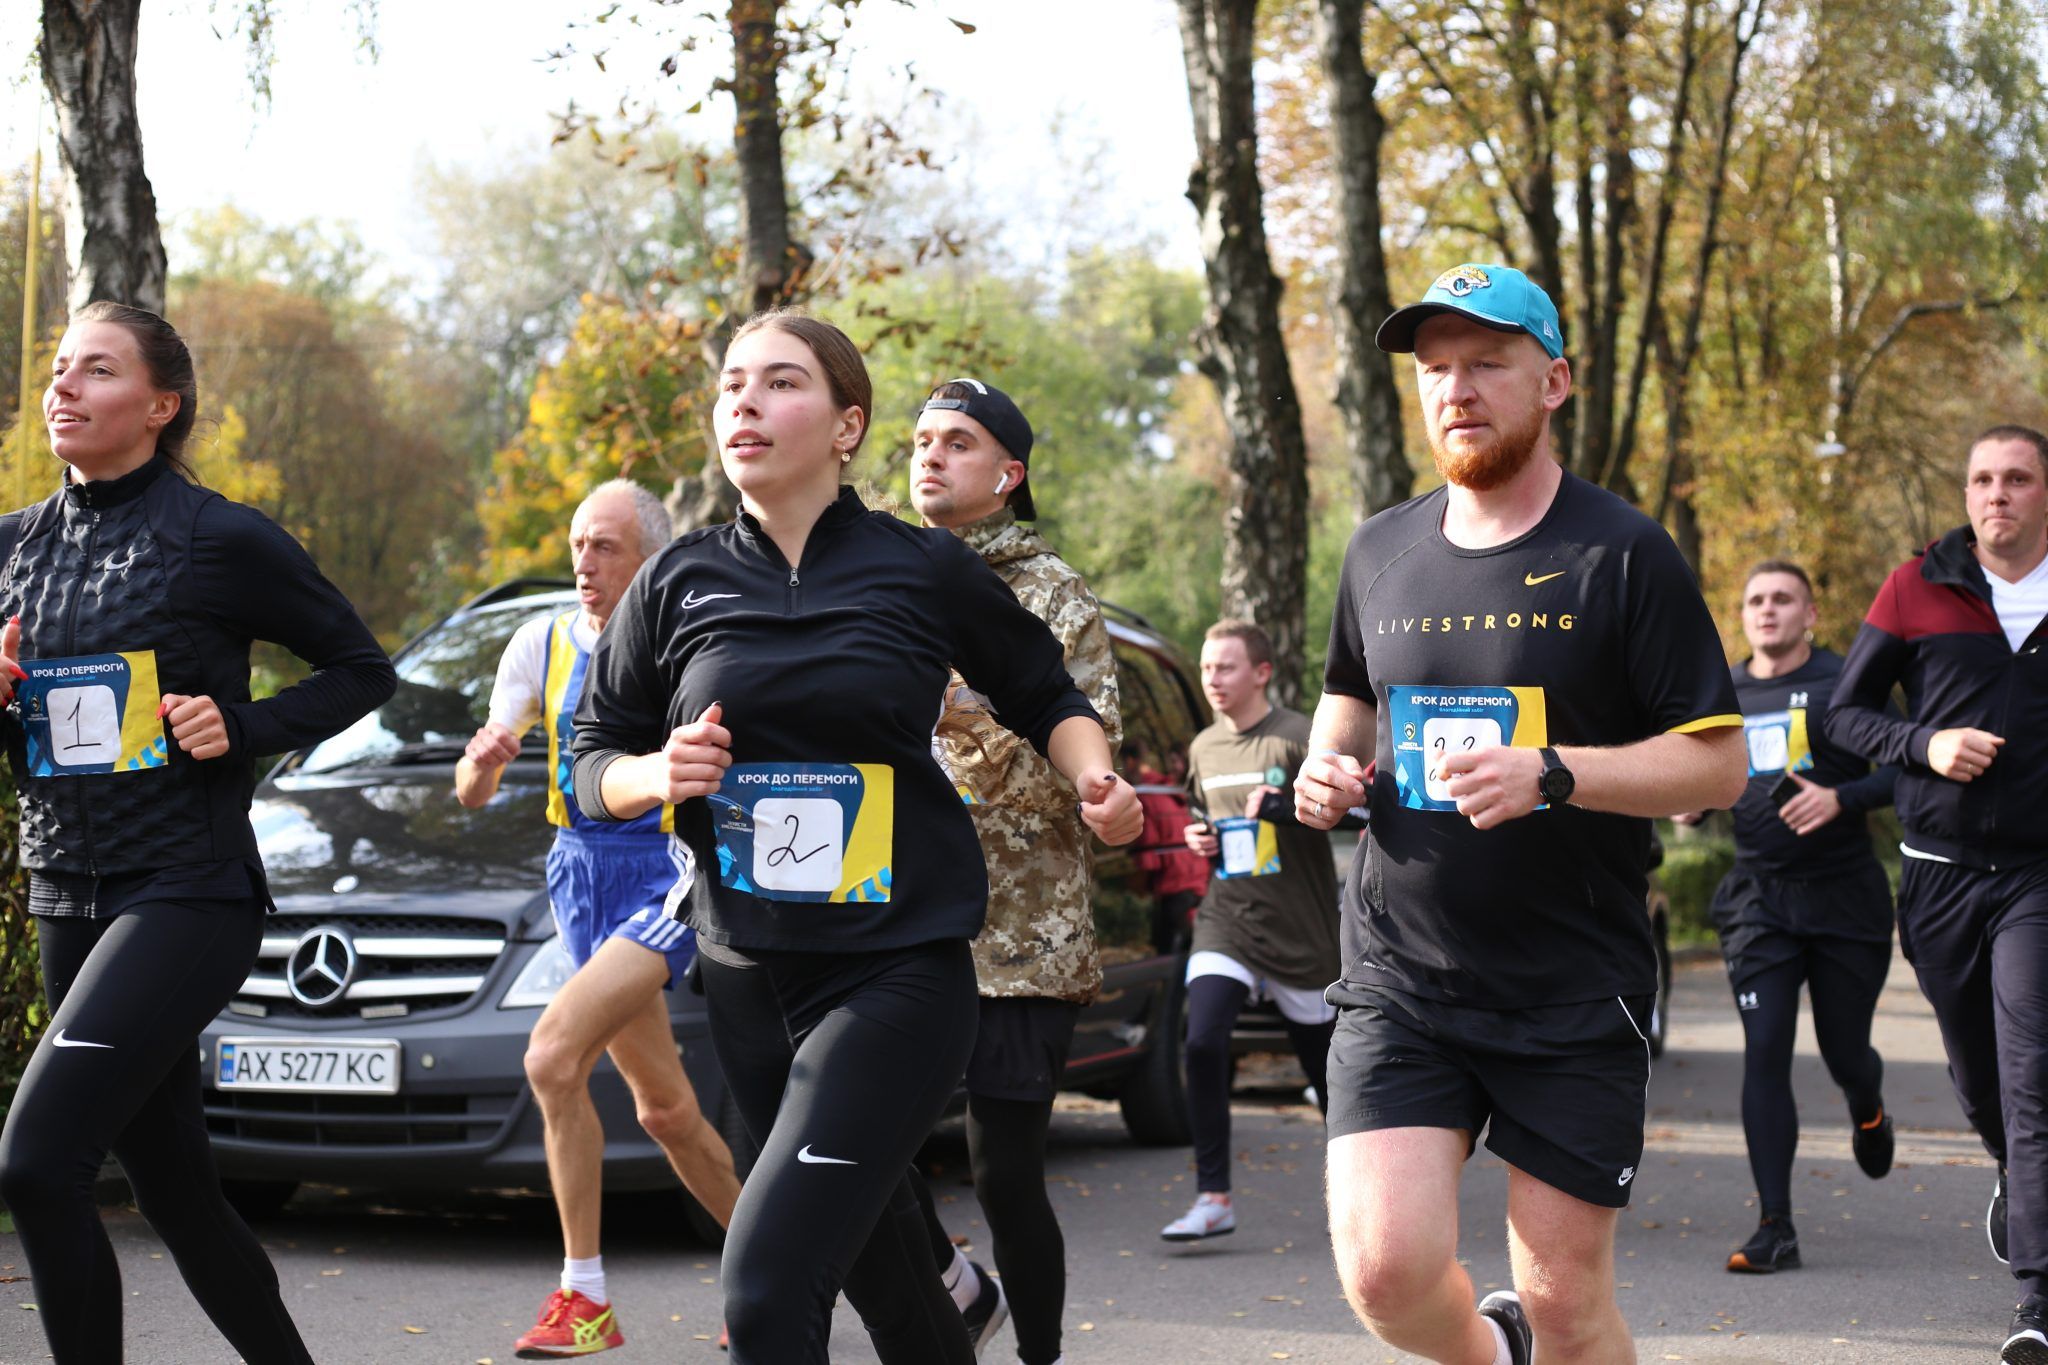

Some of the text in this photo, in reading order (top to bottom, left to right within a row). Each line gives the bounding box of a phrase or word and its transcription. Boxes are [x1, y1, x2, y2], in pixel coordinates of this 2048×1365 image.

[1378, 613, 1574, 634] LIVESTRONG
[32, 663, 124, 678] КРОК ДО ПЕРЕМОГИ
[1411, 695, 1512, 706] КРОК ДО ПЕРЕМОГИ
[63, 696, 102, 750] 1
[738, 774, 858, 785] КРОК ДО ПЕРЕМОГИ
[767, 814, 830, 867] 2
[236, 1052, 385, 1082] AX 5277 KC
